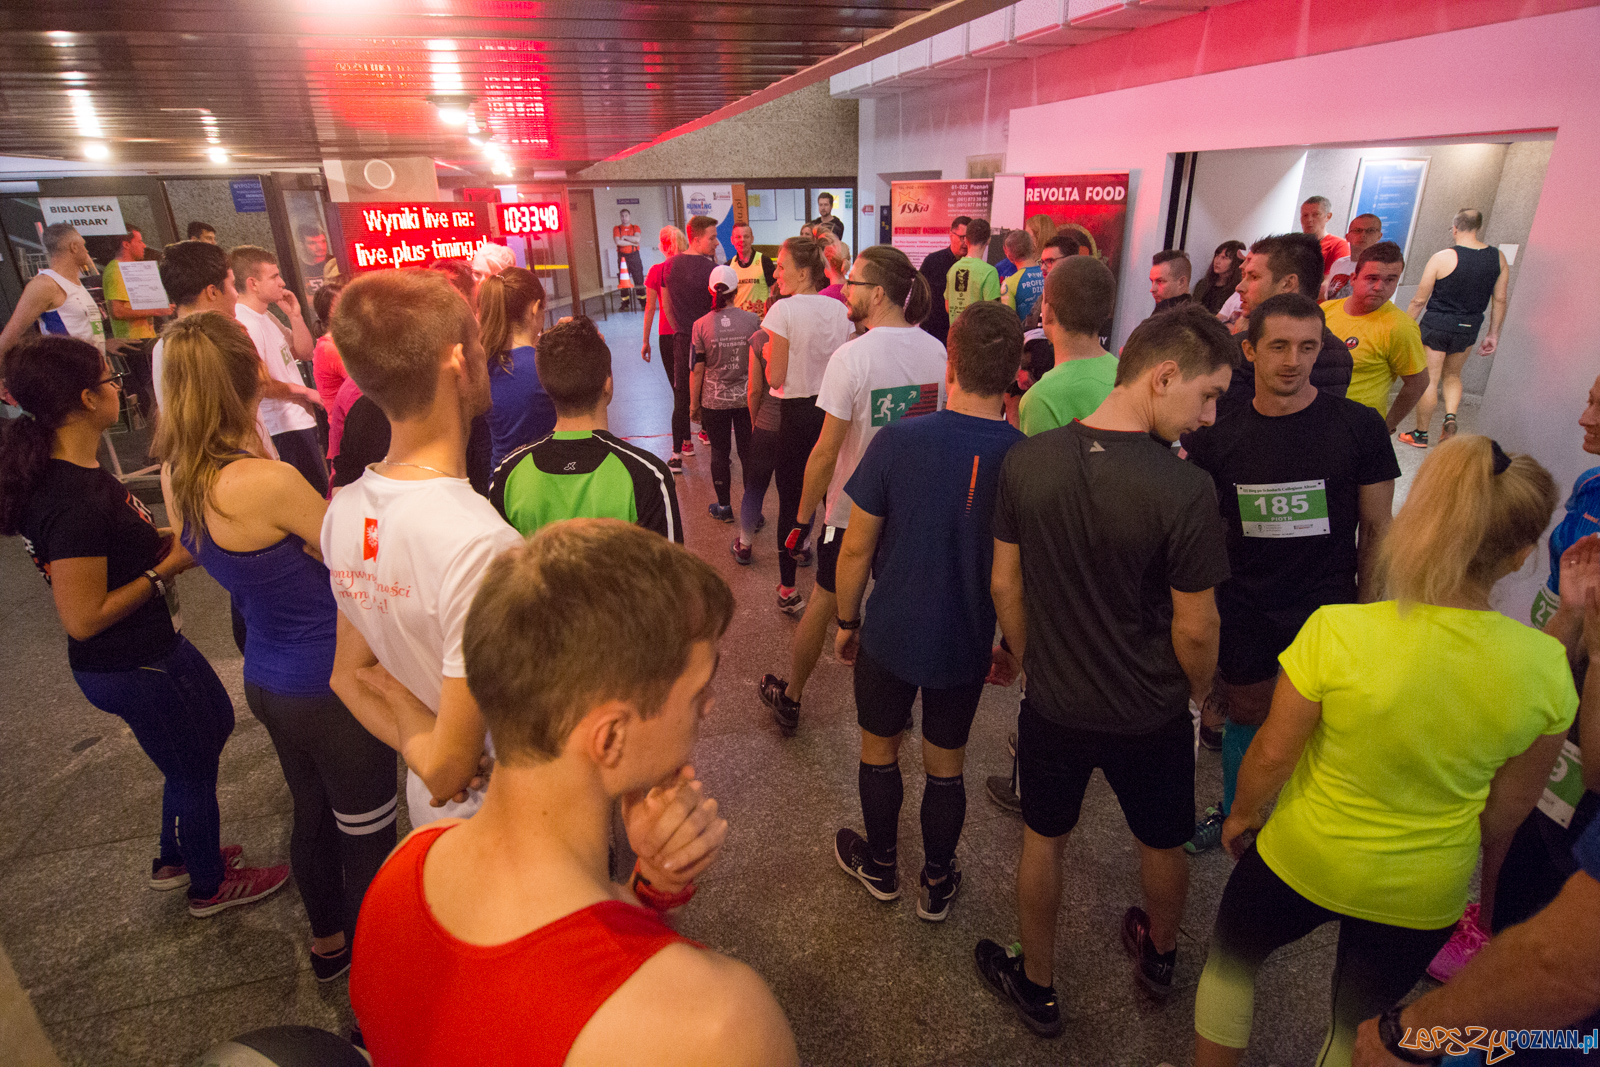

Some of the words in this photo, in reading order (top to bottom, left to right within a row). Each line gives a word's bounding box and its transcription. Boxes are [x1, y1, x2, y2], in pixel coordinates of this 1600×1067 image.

[1025, 187, 1080, 201] REVOLTA
[1085, 186, 1125, 201] FOOD
[49, 205, 113, 213] BIBLIOTEKA
[362, 206, 420, 236] Wyniki
[422, 206, 449, 229] live
[452, 210, 475, 227] na:
[718, 340, 747, 348] Poznaniu
[1254, 494, 1309, 515] 185
